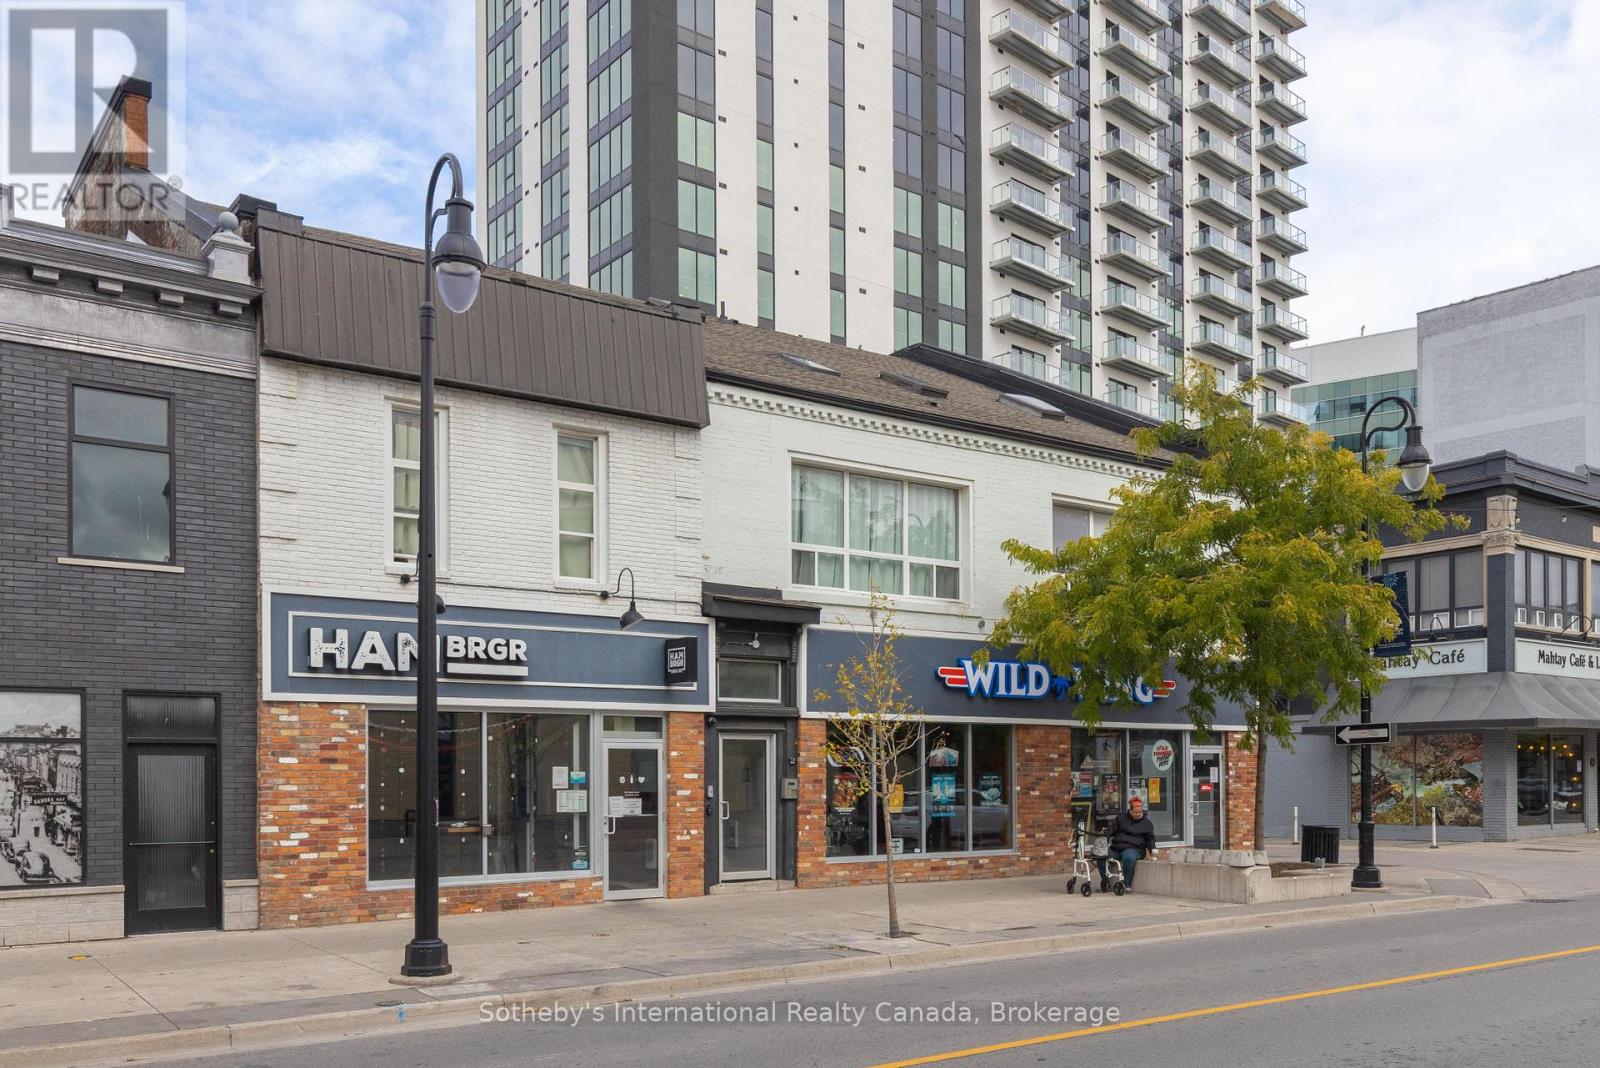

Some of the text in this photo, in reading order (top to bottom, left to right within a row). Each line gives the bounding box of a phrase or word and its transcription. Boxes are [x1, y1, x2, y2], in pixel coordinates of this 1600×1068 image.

[446, 635, 528, 661] BRGR
[1429, 648, 1465, 665] Café
[1538, 650, 1567, 668] Mahtay
[1570, 653, 1586, 667] Café
[1588, 655, 1594, 668] &
[961, 659, 1050, 697] WILD
